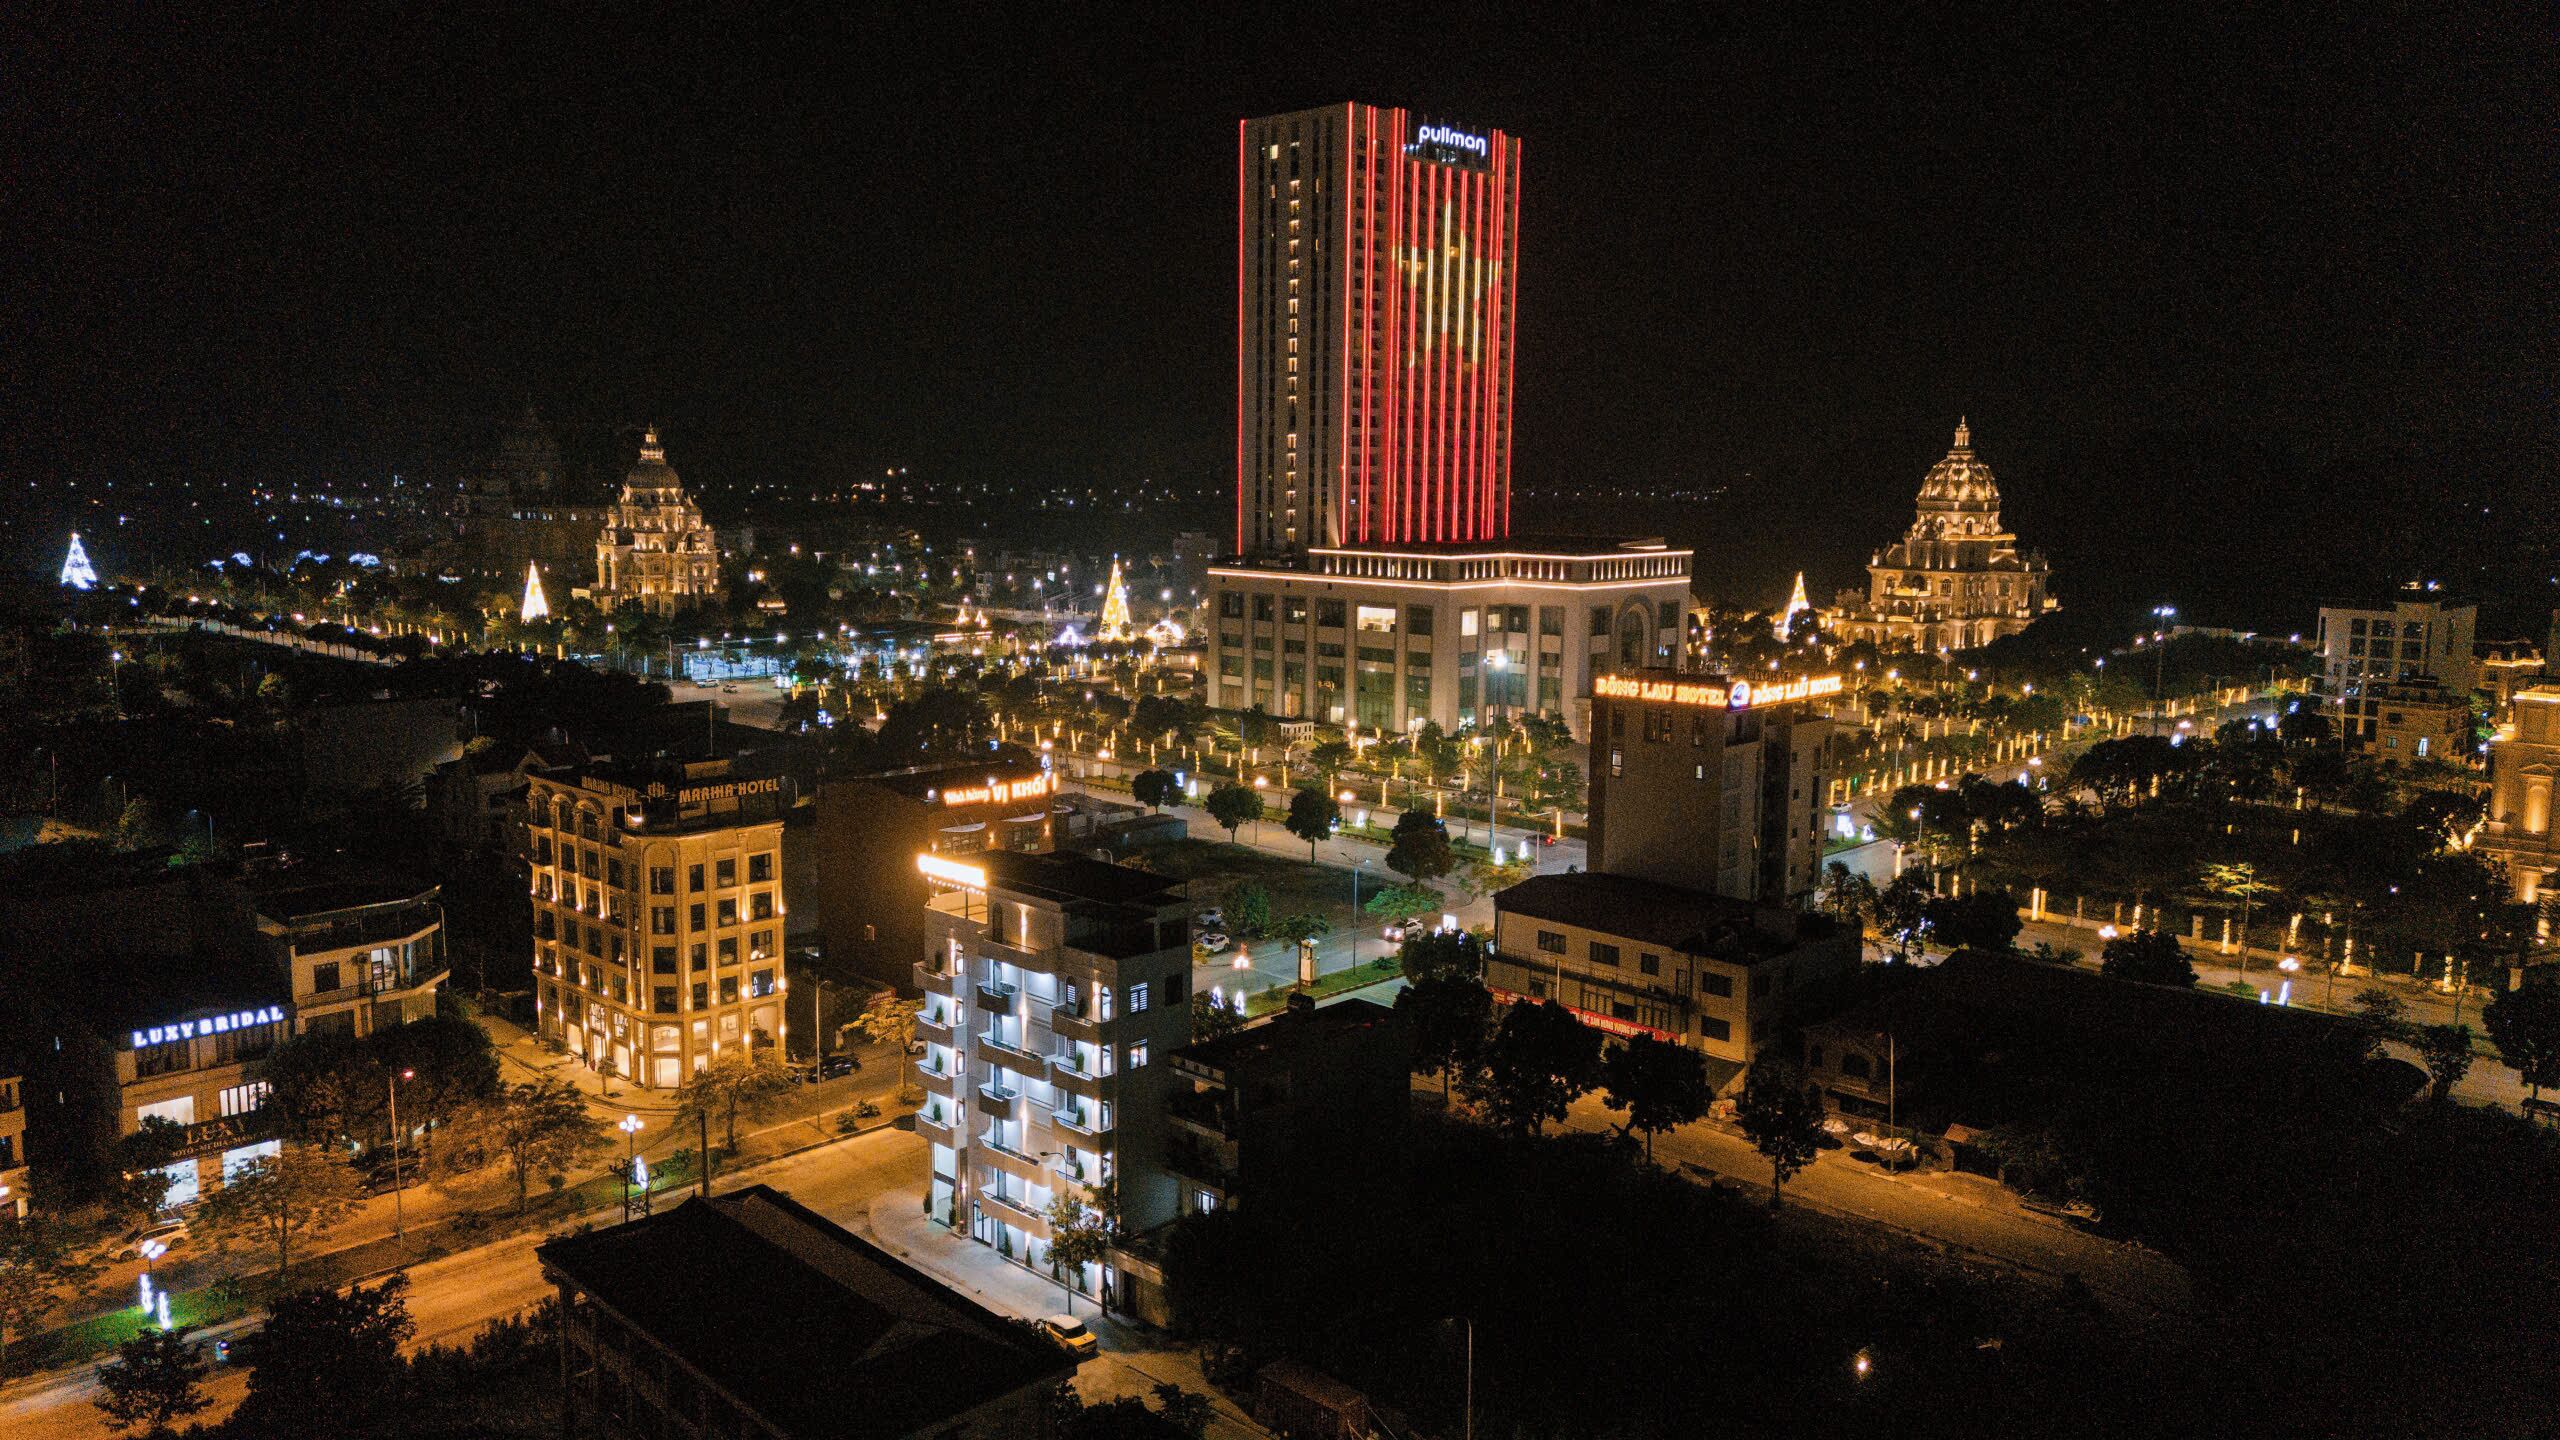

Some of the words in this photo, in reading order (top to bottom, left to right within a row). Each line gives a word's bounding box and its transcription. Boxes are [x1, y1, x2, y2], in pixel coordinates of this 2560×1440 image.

[1418, 125, 1487, 157] pullman
[1641, 682, 1674, 700] LAU
[1676, 686, 1728, 707] HOTEL
[1810, 676, 1842, 695] HOTEL
[738, 778, 780, 796] HOTEL
[133, 1021, 195, 1048] LUXY
[199, 1005, 285, 1035] BRIDAL
